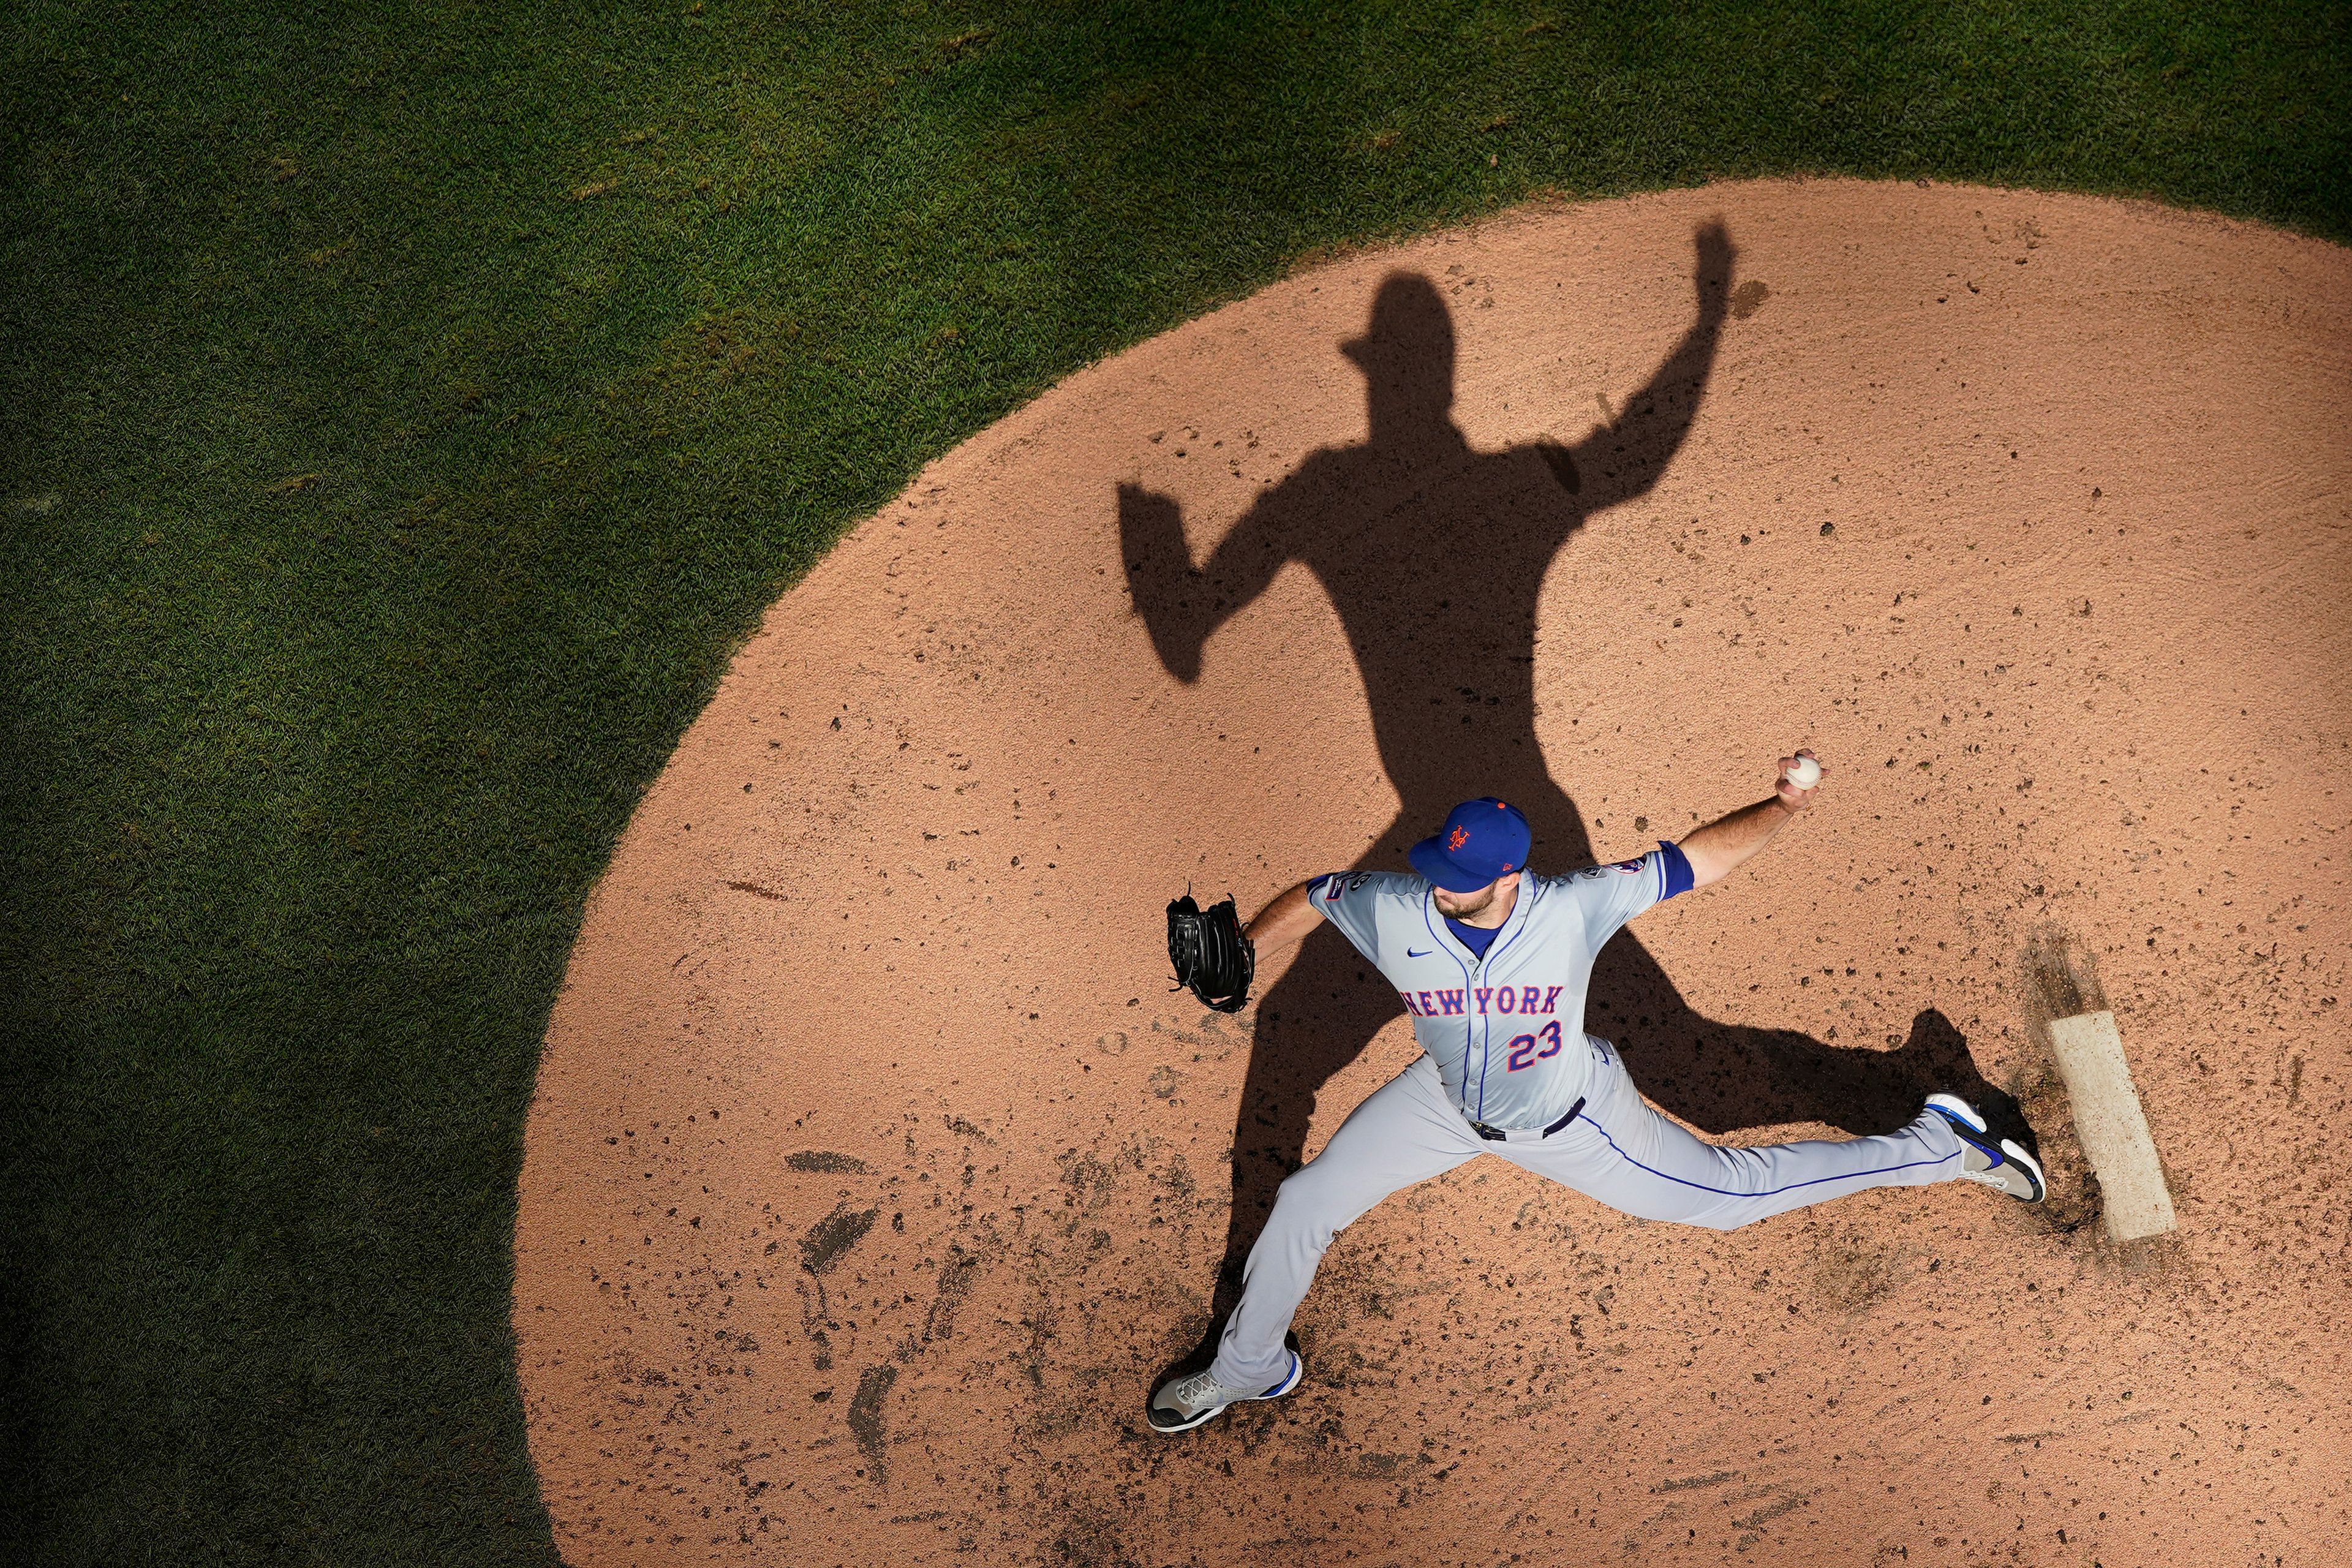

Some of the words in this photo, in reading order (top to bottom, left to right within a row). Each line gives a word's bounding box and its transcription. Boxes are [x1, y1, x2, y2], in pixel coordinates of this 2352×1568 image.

[1400, 989, 1465, 1017] NEW
[1474, 986, 1564, 1015] YORK
[1507, 1019, 1562, 1072] 23
